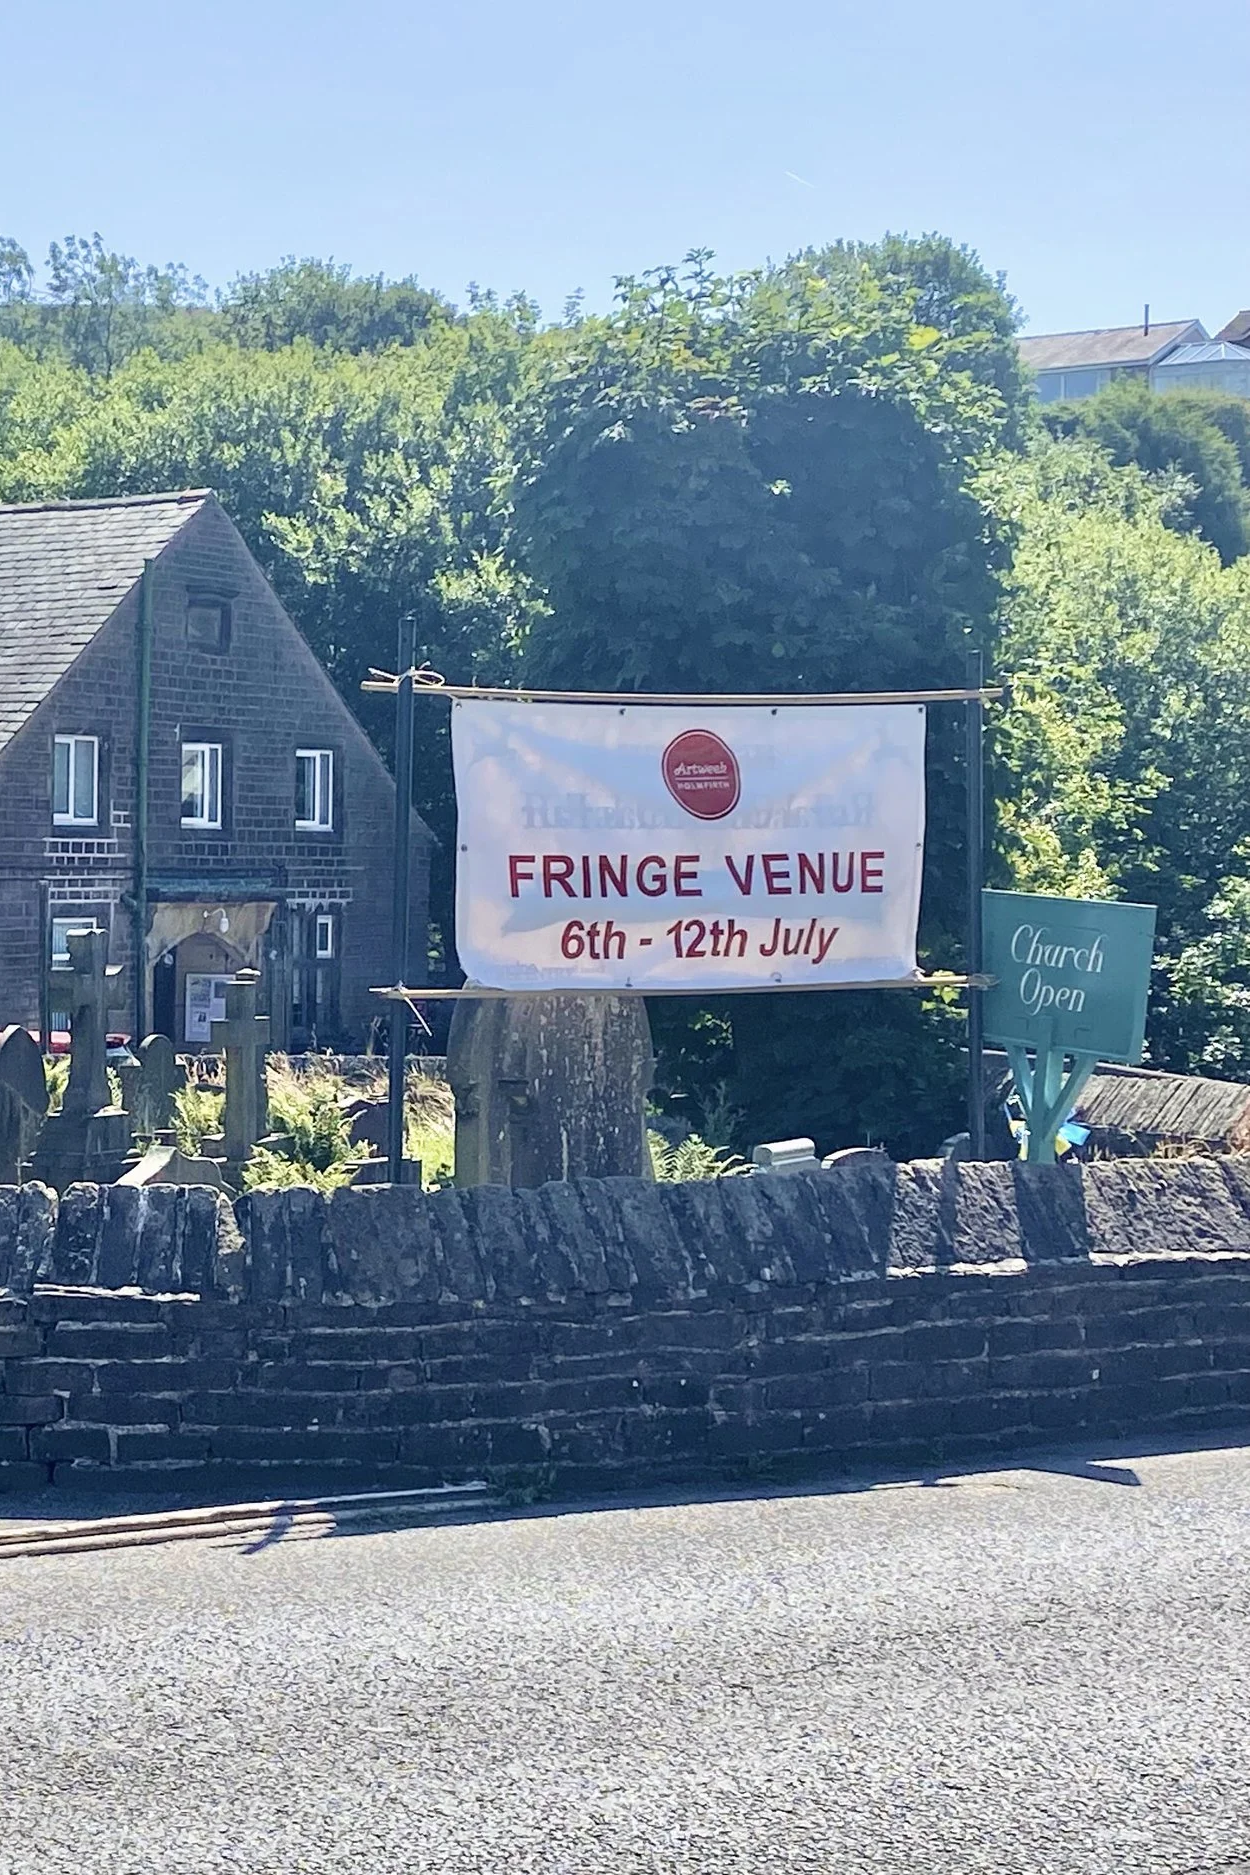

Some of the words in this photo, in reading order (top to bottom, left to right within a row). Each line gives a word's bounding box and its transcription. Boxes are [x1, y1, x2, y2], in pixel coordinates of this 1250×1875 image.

[673, 762, 727, 776] Artweek
[676, 781, 730, 790] HOLMFIRTH
[509, 855, 702, 898] FRINGE
[725, 852, 884, 895] VENUE
[561, 920, 626, 959] 6th
[667, 919, 747, 958] 12th
[760, 918, 839, 964] July
[1011, 924, 1109, 973] Church
[1020, 968, 1085, 1016] Open
